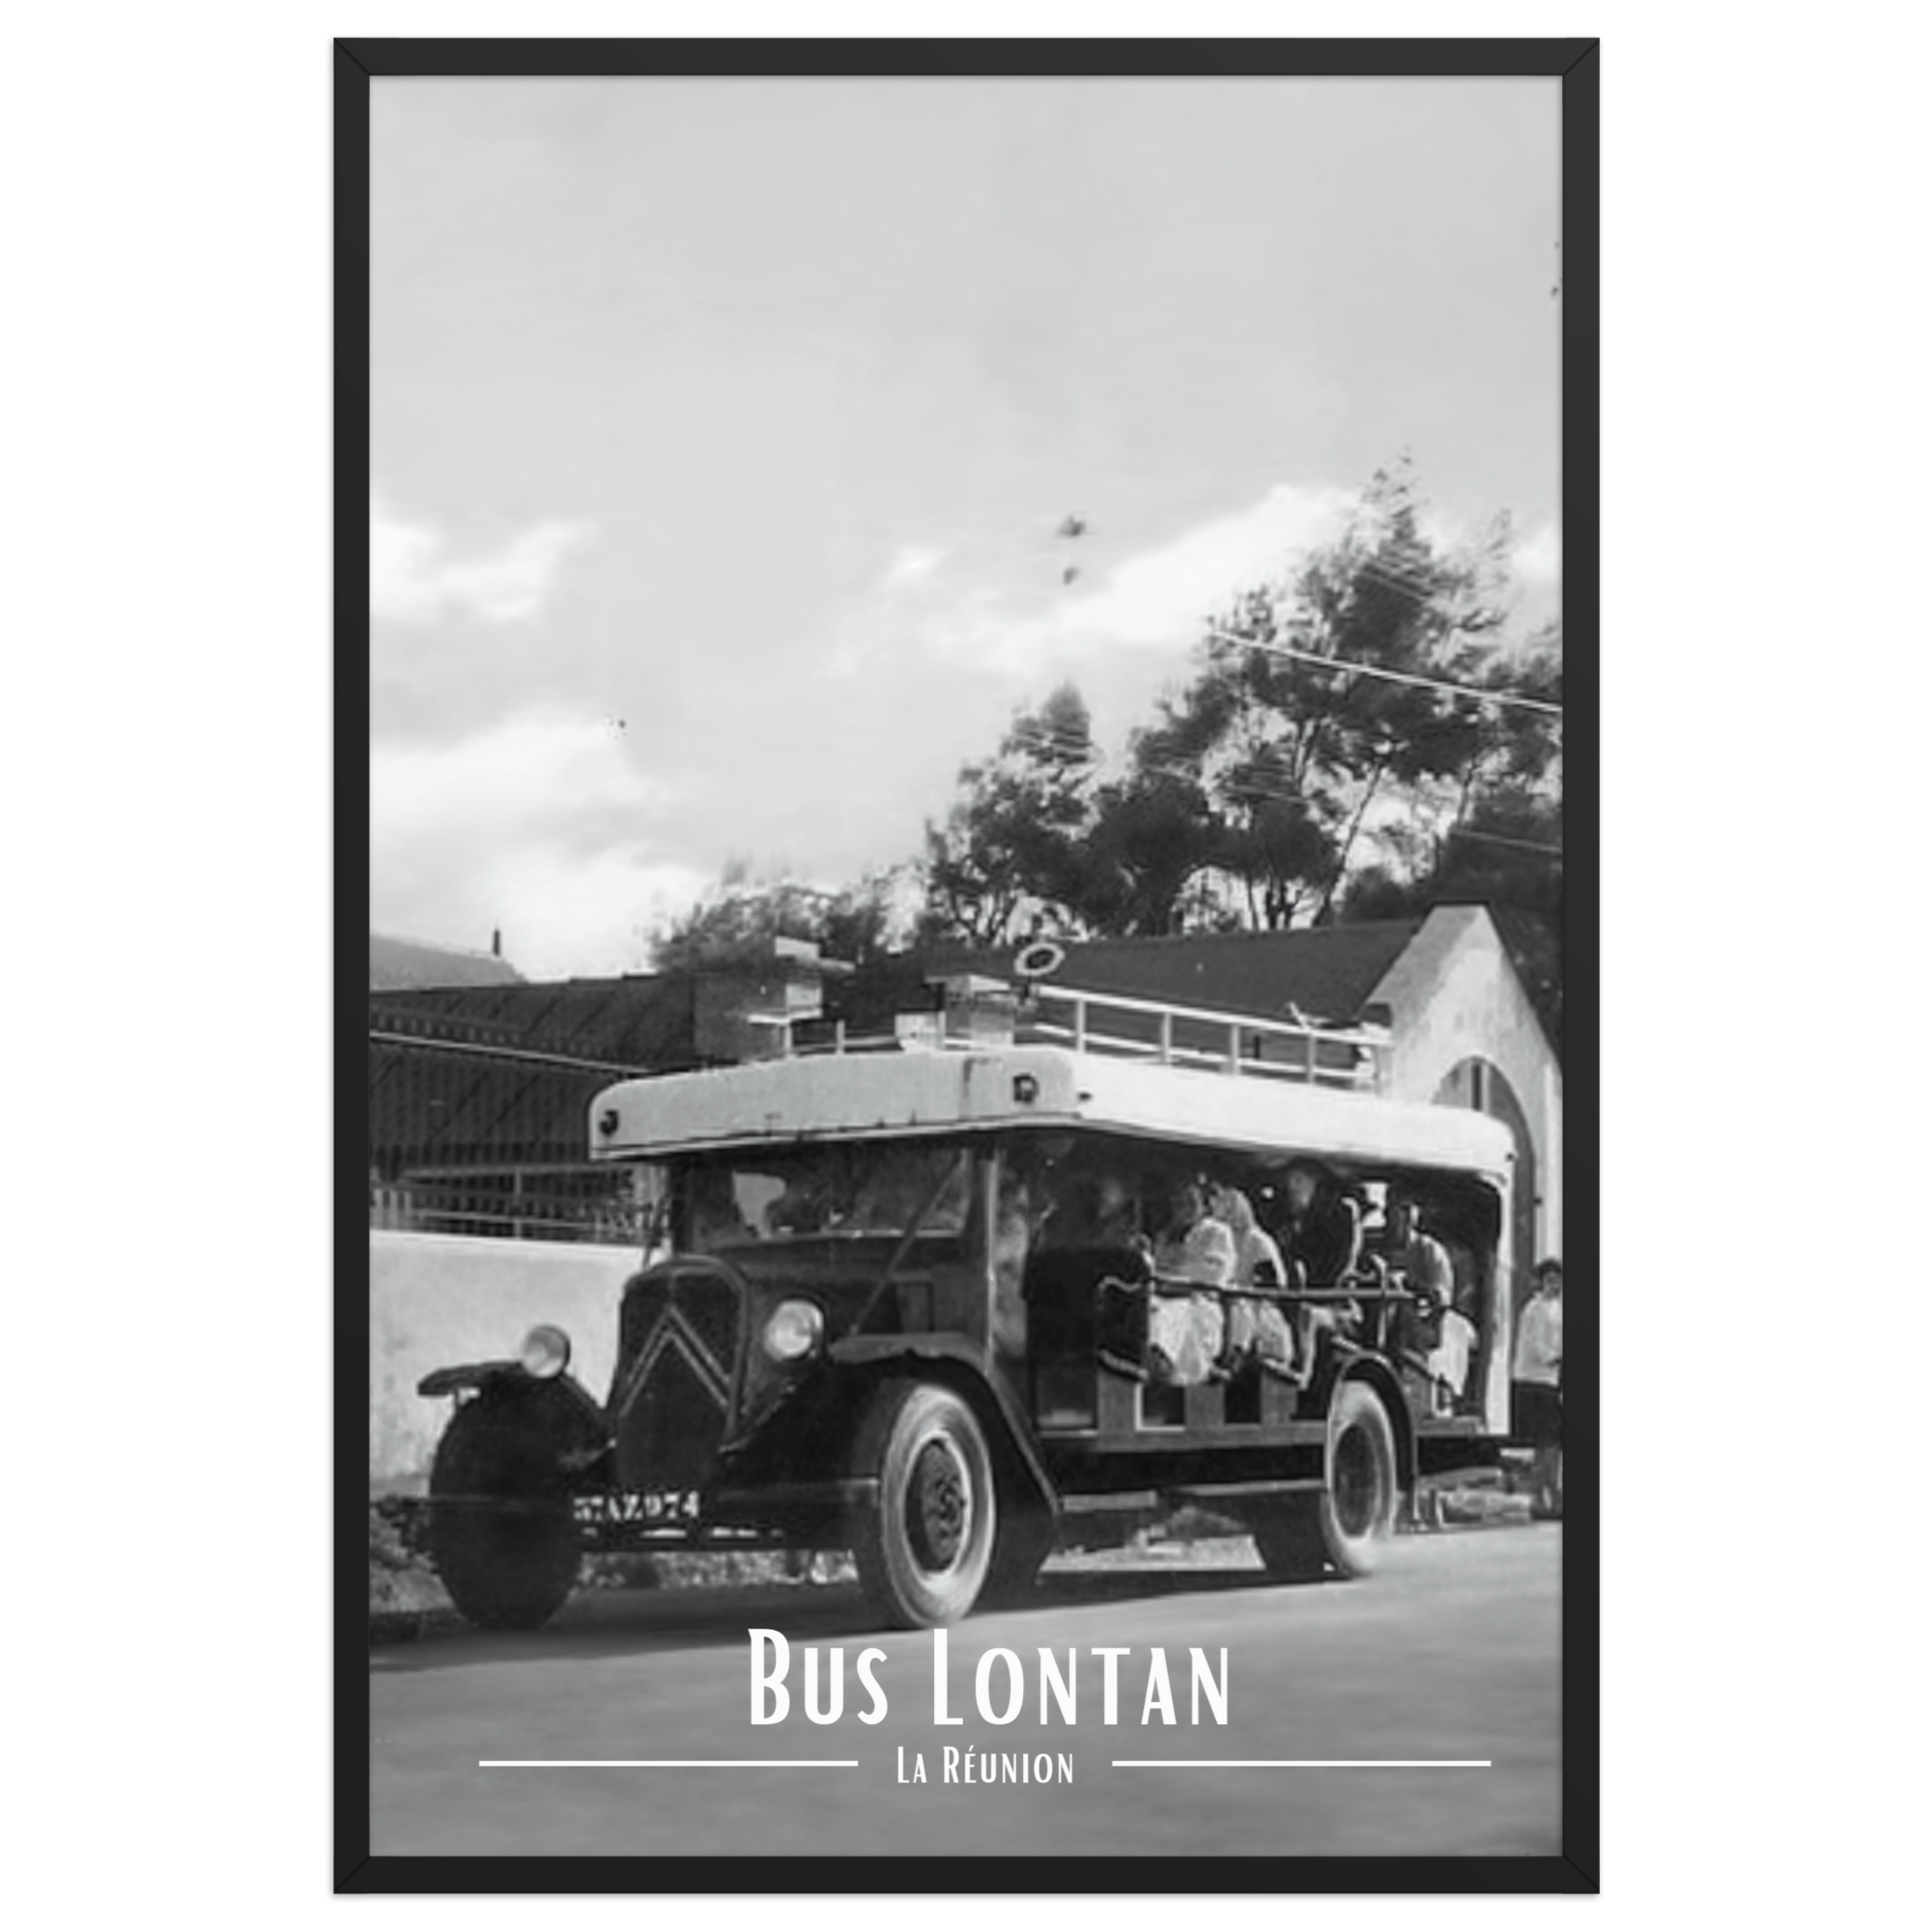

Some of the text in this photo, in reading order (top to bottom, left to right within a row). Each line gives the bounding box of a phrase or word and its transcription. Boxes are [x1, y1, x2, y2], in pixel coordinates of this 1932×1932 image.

[749, 1629, 1228, 1725] BUS LONTAN
[897, 1745, 1072, 1783] LA RÉUNION
